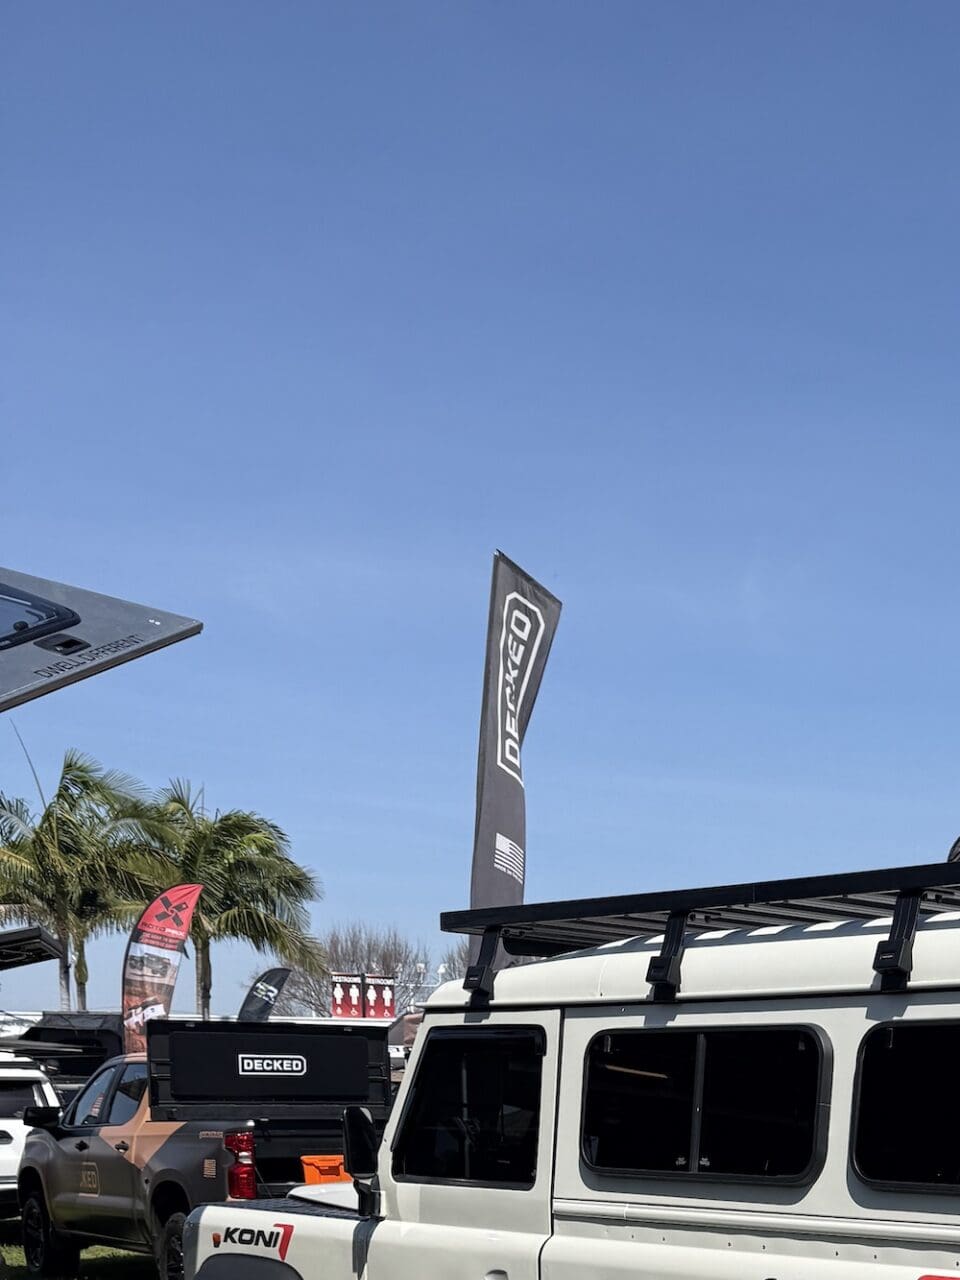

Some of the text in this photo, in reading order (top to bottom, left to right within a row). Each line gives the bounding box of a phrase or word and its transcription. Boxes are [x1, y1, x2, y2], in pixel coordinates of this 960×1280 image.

[34, 633, 143, 679] DWELL DIFFERENT
[242, 1058, 303, 1072] DECKED
[223, 1227, 280, 1248] KONI
